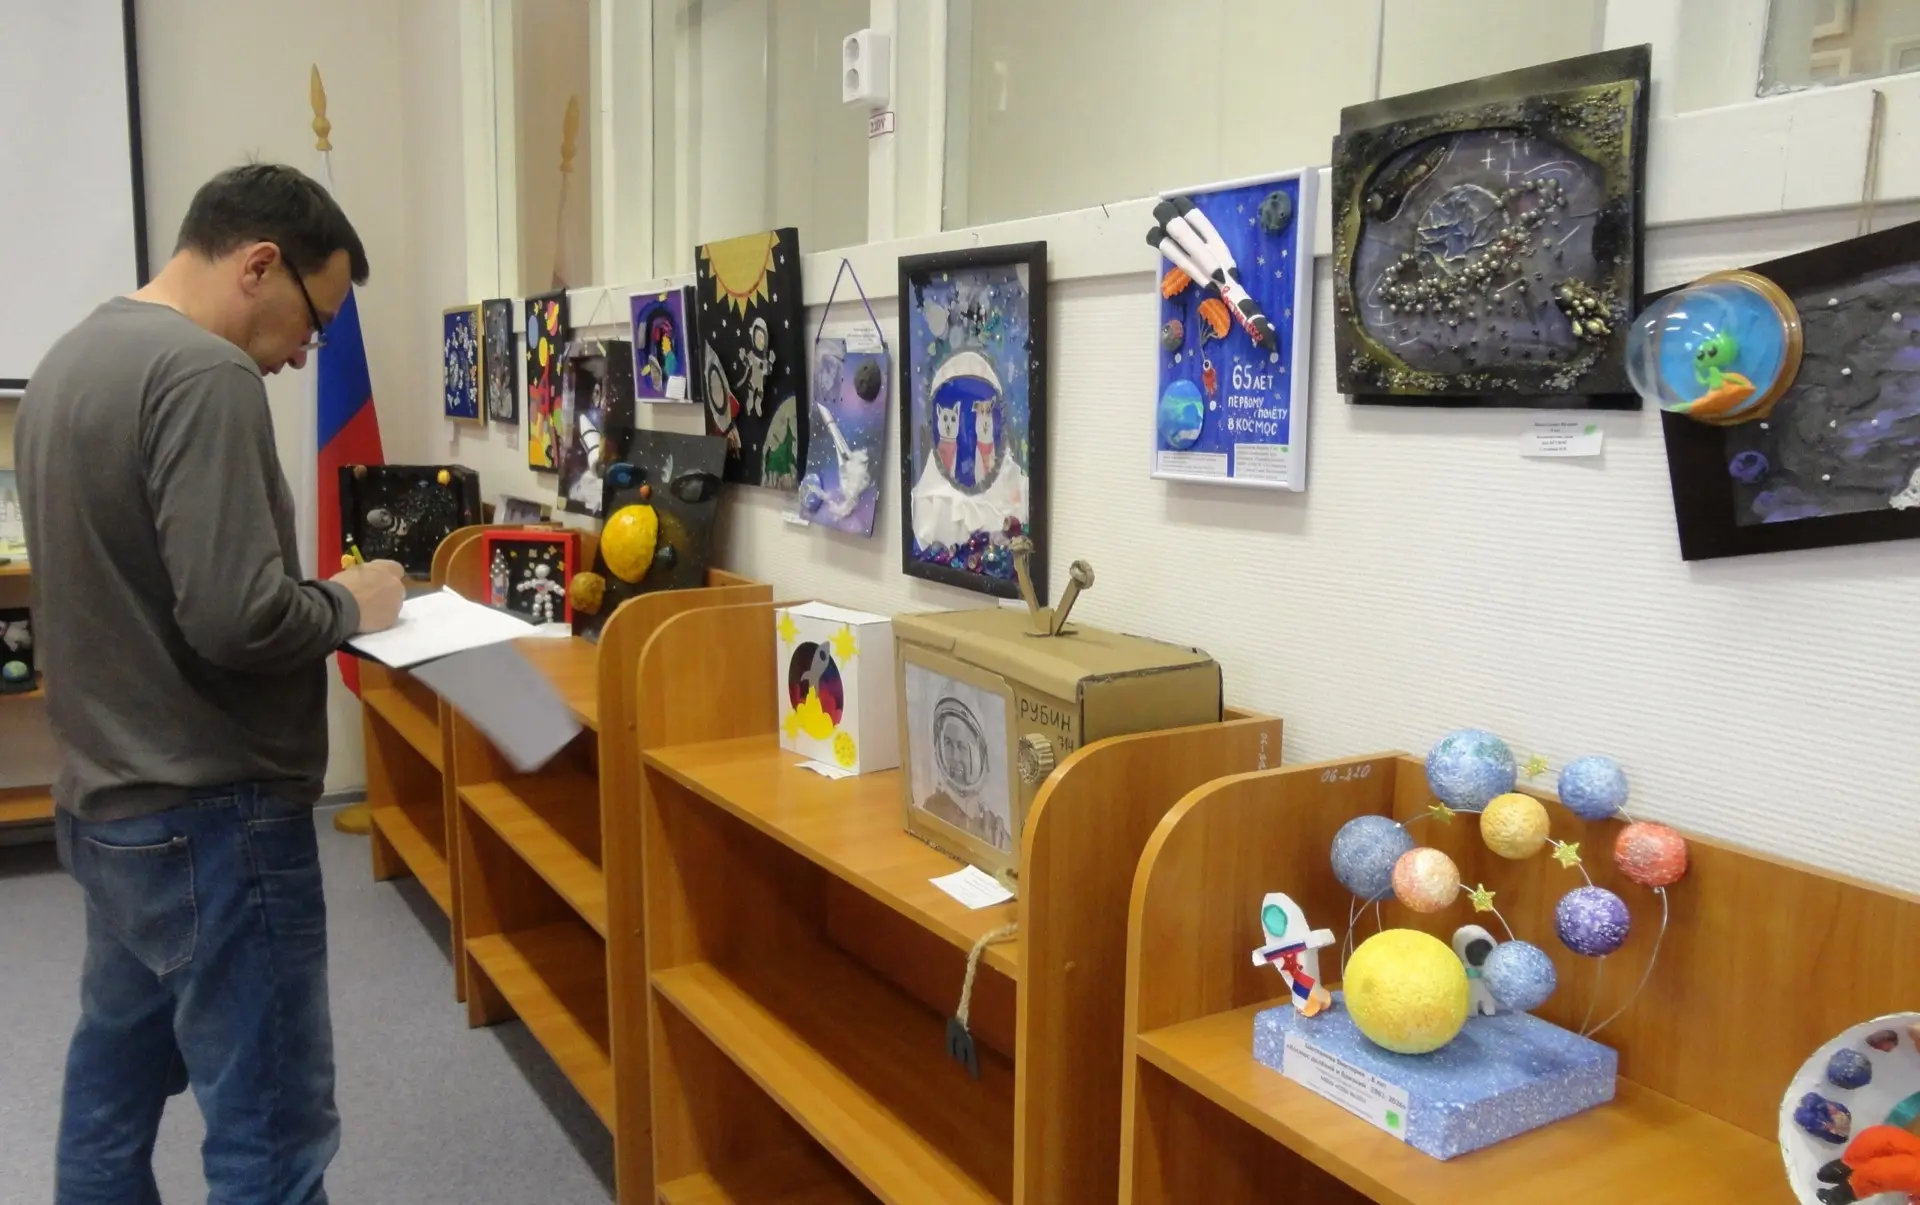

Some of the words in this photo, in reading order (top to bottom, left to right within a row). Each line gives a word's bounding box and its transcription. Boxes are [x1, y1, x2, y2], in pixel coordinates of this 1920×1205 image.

[1232, 364, 1252, 390] 65
[1253, 375, 1273, 390] ЛЕТ
[1228, 395, 1264, 409] ПЕРВОМУ
[1258, 406, 1287, 420] ПОЛЁТУ
[1228, 417, 1234, 430] В
[1236, 418, 1278, 436] КОСМОС
[1020, 698, 1071, 732] РУБИН
